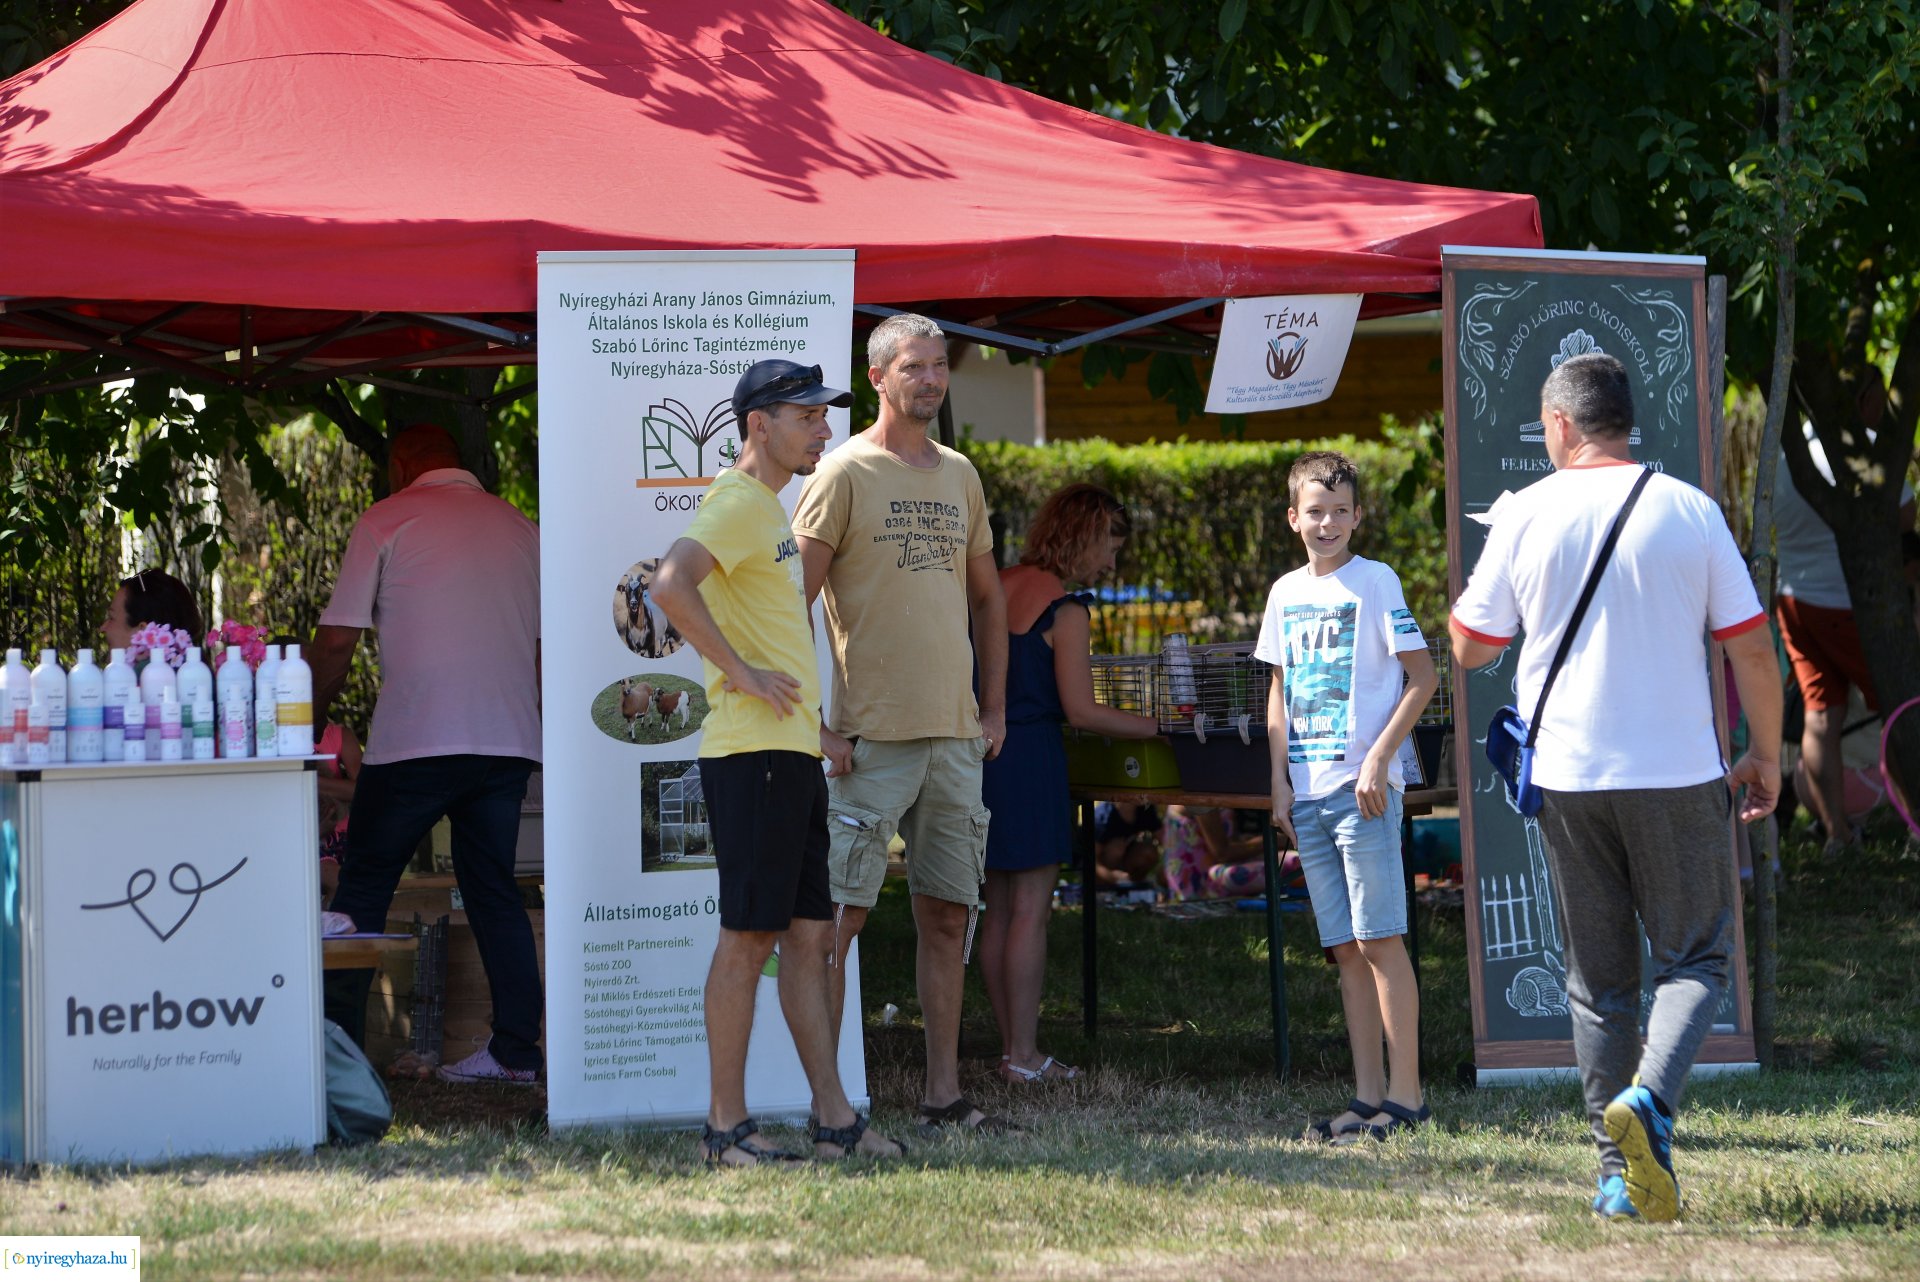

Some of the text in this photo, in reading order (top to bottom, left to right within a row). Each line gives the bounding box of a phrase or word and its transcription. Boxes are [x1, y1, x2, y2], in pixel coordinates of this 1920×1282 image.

[559, 290, 836, 311] Nyíregyházi Arany János Gimnázium,
[588, 312, 809, 331] Általános Iskola és Kollégium
[1263, 306, 1319, 329] TÉMA
[592, 335, 807, 354] Szabó Lőrinc Tagintézménye
[1501, 322, 1531, 381] SZABÓ
[1529, 300, 1585, 329] LŐRINC
[890, 500, 959, 518] DEVERGO
[873, 533, 906, 543] EASTERN
[913, 533, 948, 543] DOCKS
[1289, 618, 1342, 665] NYC
[1293, 715, 1334, 733] NEW YORK
[584, 900, 699, 922] Állatsimogató
[583, 936, 694, 954] Kiemelt Partnereink:
[584, 959, 632, 972] Sóstó ZOO
[601, 990, 630, 1002] Miklós
[633, 988, 676, 1001] Erdészeti
[67, 990, 266, 1037] herbow
[584, 1005, 634, 1020] Sóstóhegyi
[636, 1003, 690, 1017] Gyerekvilág
[584, 1040, 612, 1051] Szabó
[645, 1034, 693, 1047] Támogatói
[93, 1050, 242, 1072] Naturally for the Family
[584, 1055, 610, 1068] Igrice
[619, 1069, 642, 1079] Farm
